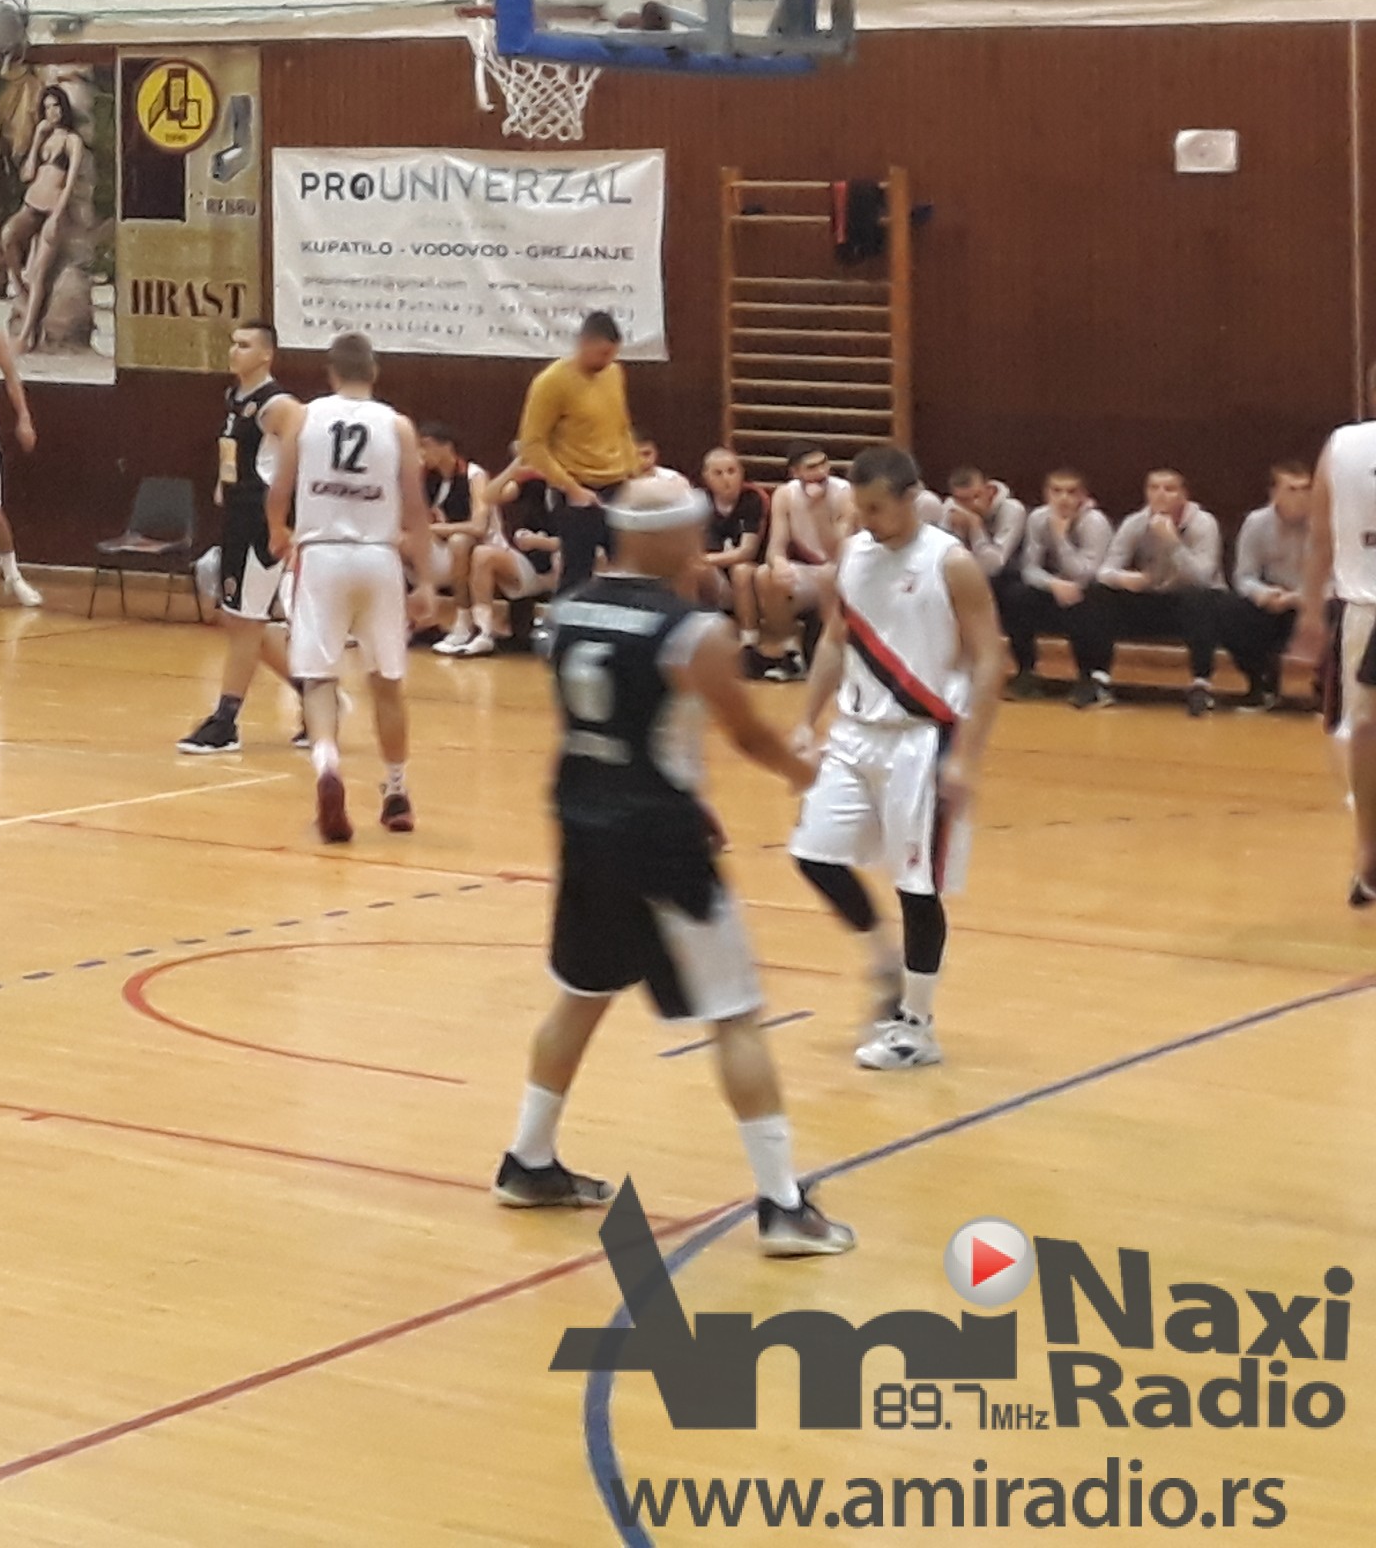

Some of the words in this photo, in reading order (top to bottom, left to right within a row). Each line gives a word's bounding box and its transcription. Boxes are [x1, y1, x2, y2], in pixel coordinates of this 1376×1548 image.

[300, 166, 632, 203] PROUNIVERZAL
[301, 241, 393, 255] KUPATILO
[526, 245, 635, 260] GREJANJE
[130, 278, 247, 320] HRAST
[329, 419, 369, 473] 12
